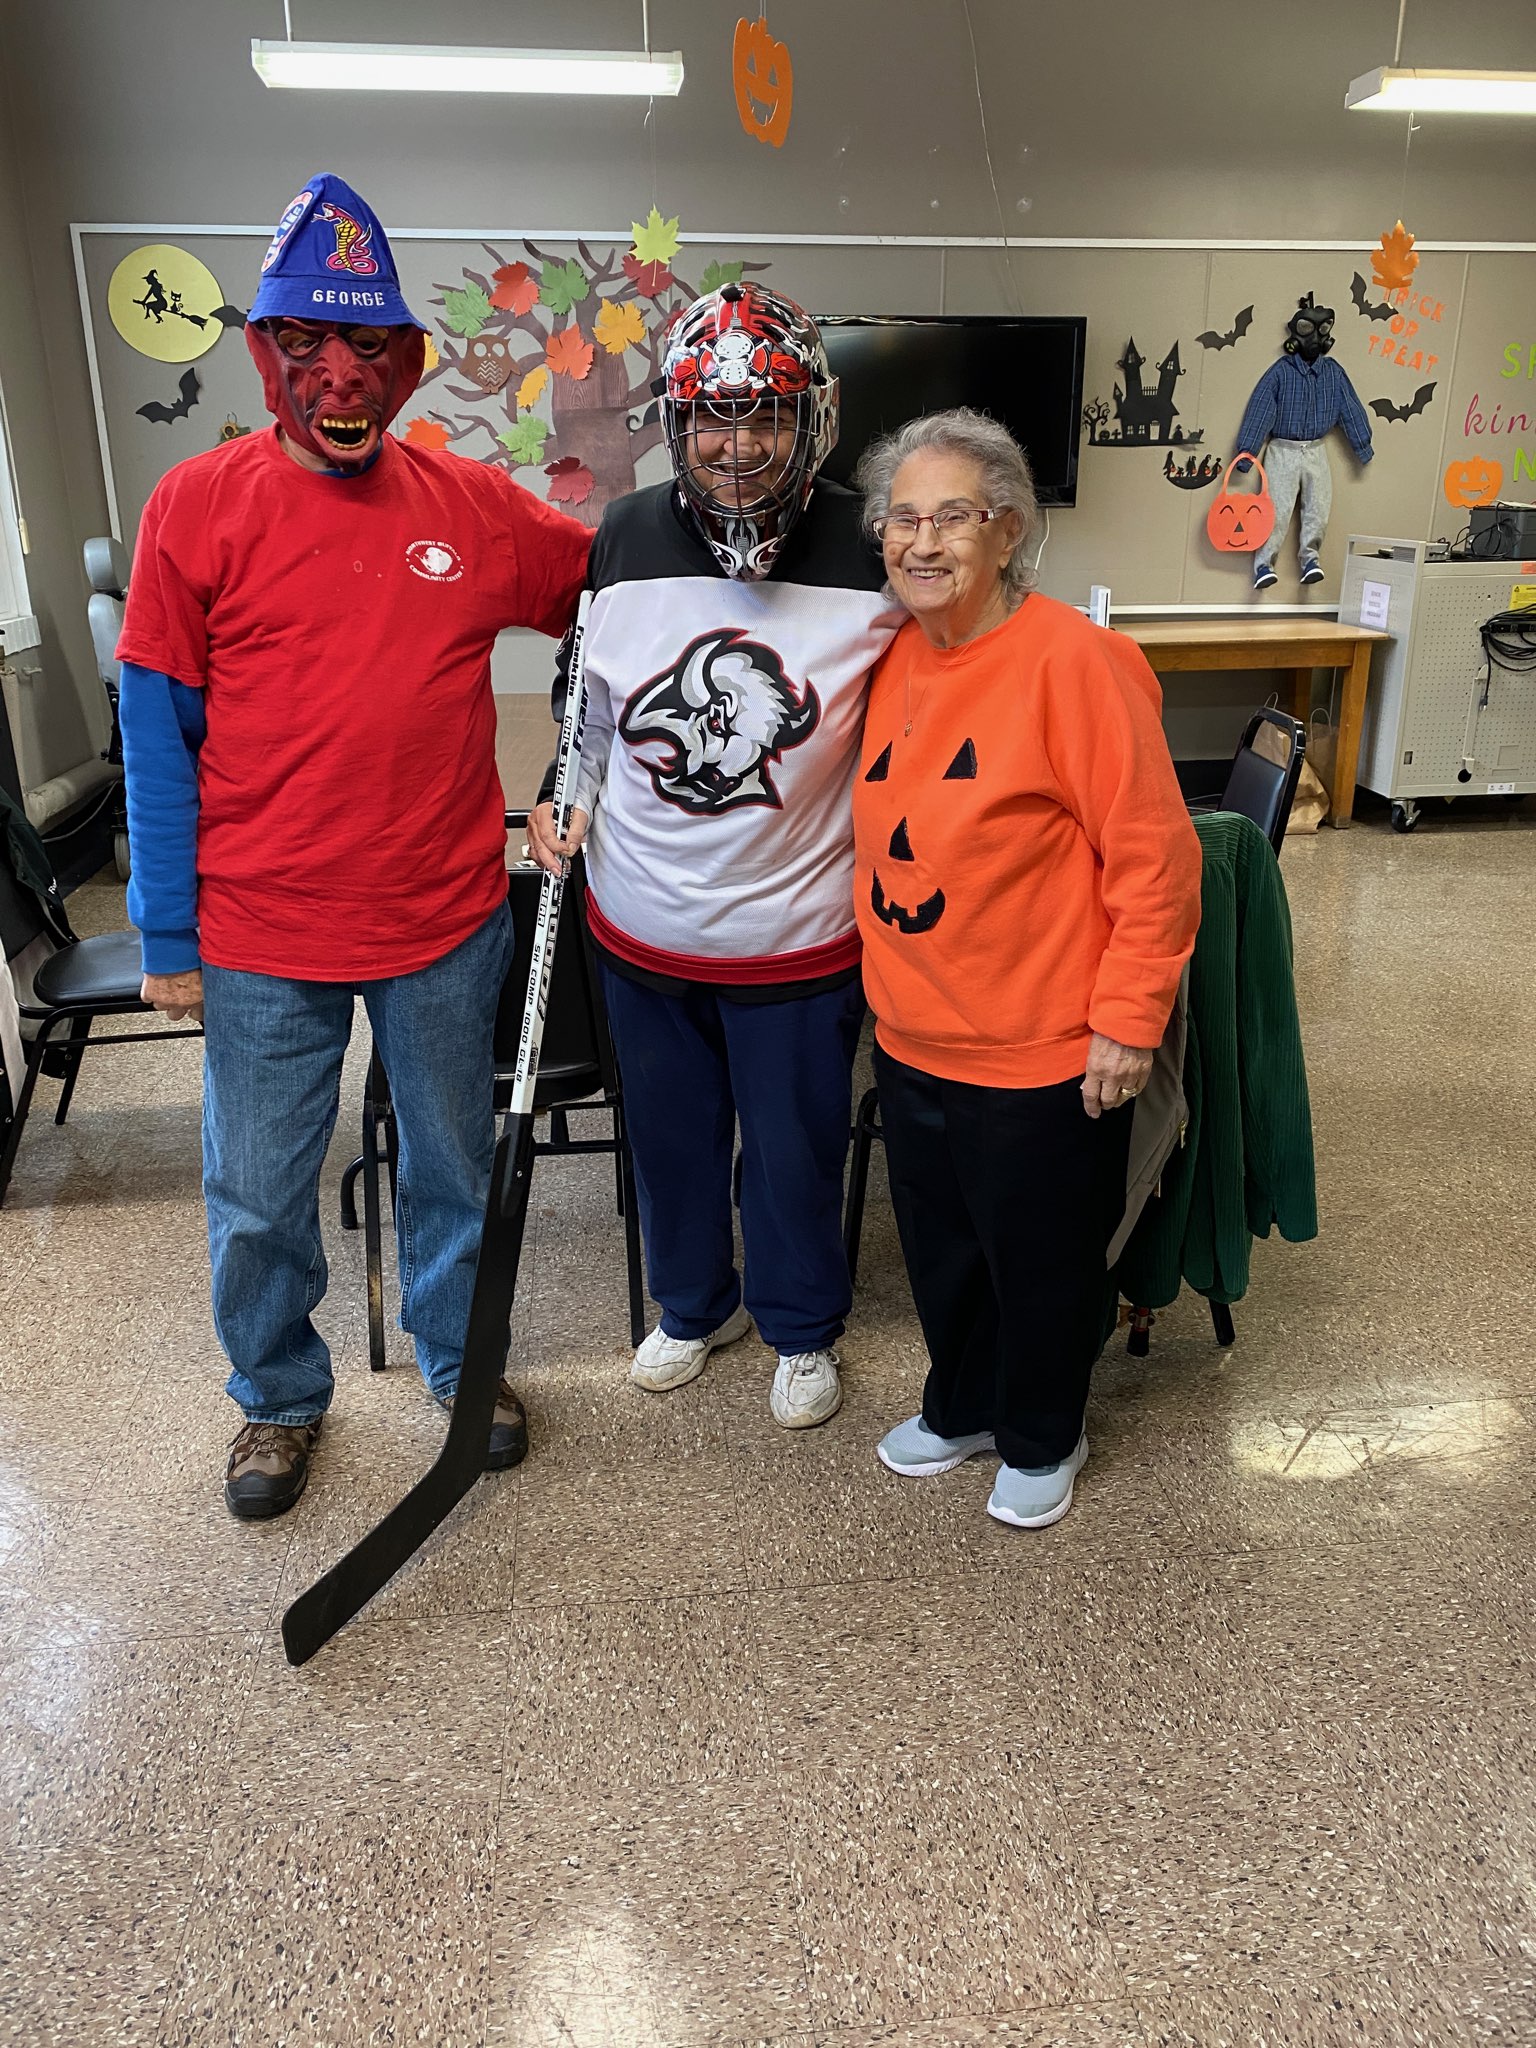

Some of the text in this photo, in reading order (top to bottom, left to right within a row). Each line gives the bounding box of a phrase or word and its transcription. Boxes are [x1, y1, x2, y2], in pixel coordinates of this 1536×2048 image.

[312, 289, 385, 307] GEORGE
[1390, 314, 1419, 340] OR
[1368, 335, 1440, 375] TREAT
[1464, 393, 1536, 437] kin
[409, 564, 463, 582] COMMUNITY CENTER
[568, 625, 585, 698] Franklin
[553, 754, 567, 812] STREET
[538, 885, 549, 928] GEAR
[532, 945, 541, 963] SH
[528, 969, 537, 1006] COMP
[522, 1012, 531, 1044] 1000
